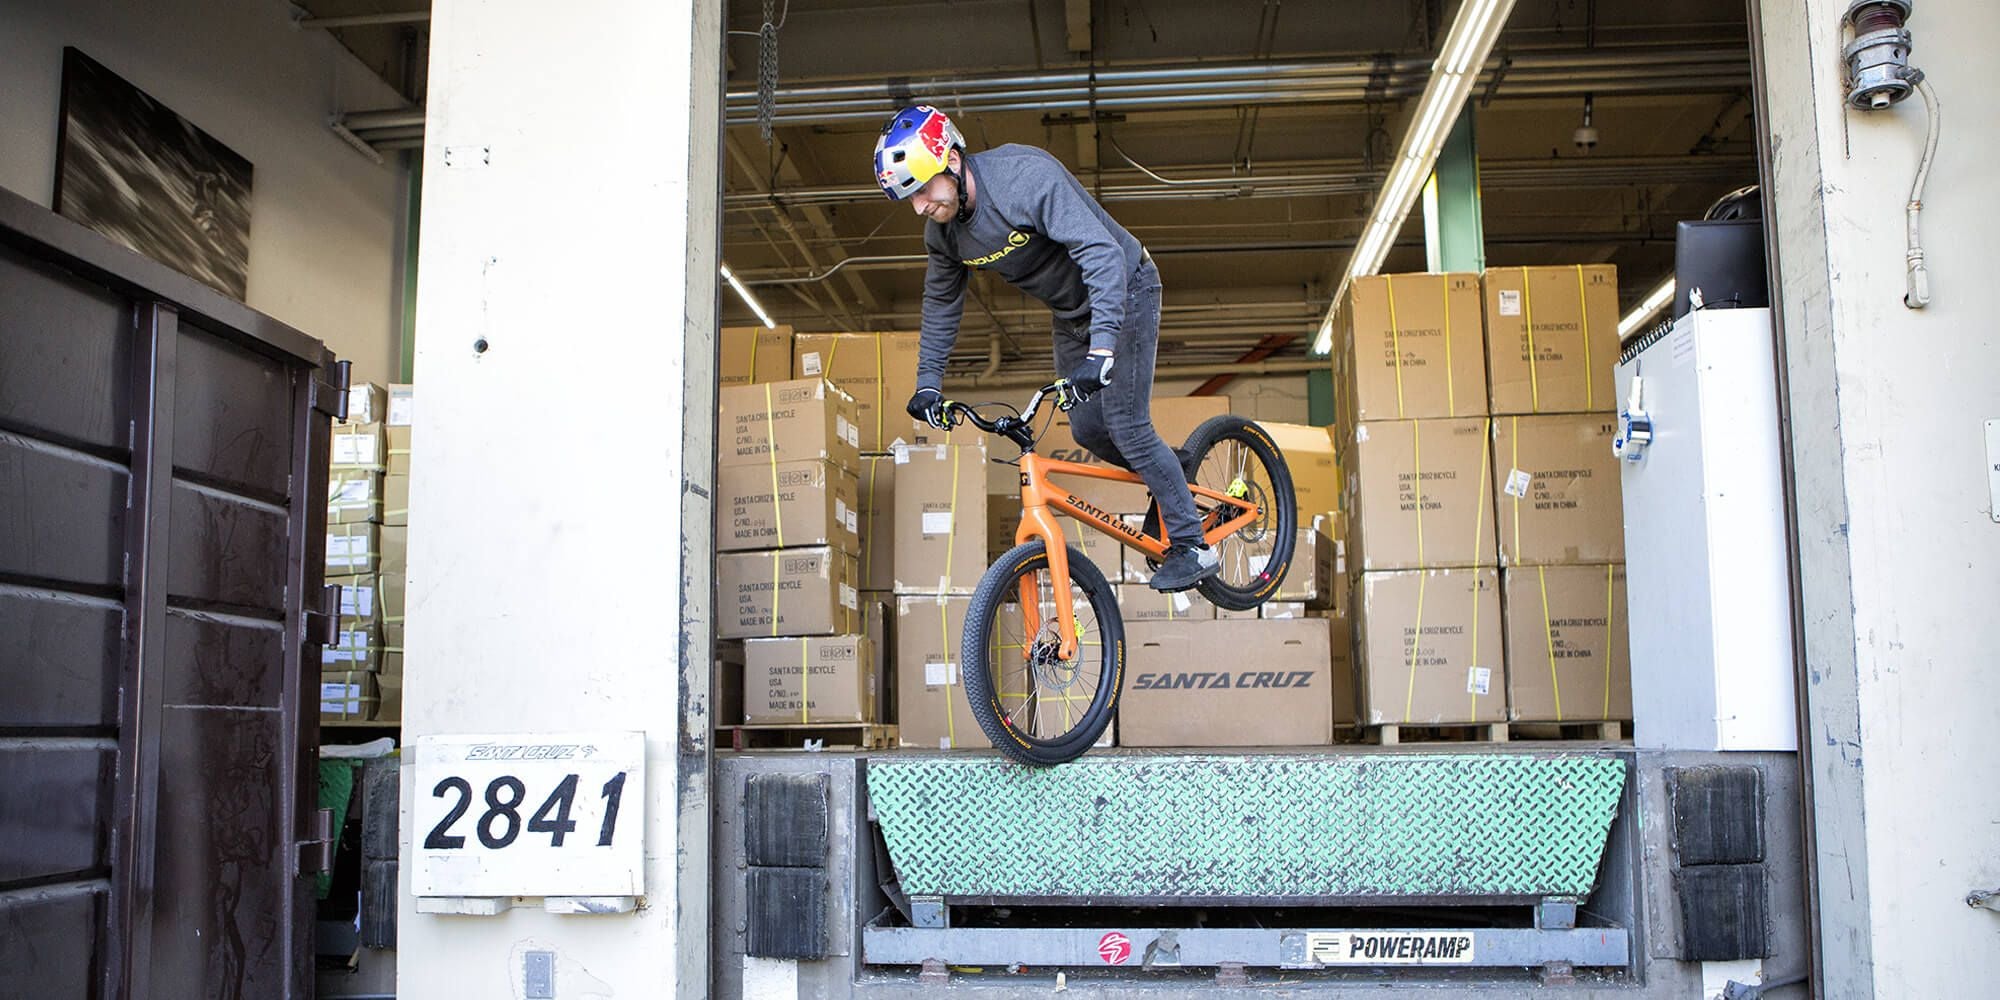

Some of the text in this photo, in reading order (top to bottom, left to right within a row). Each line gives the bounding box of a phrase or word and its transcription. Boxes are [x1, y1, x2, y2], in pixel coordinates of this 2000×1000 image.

[736, 426, 748, 434] USA
[736, 446, 754, 456] MADE
[1434, 471, 1456, 480] BICYCLE
[734, 496, 754, 506] SANTA
[754, 494, 769, 503] CRUZ
[734, 507, 746, 516] USA
[1066, 495, 1111, 524] SANTA
[735, 529, 752, 538] MADE
[738, 583, 759, 593] SANTA
[739, 594, 752, 603] USA
[740, 617, 757, 626] MADE
[1440, 625, 1464, 634] BICYCLE
[769, 666, 791, 676] SANTA
[809, 665, 836, 674] BICYCLE
[769, 678, 782, 686] USA
[1132, 671, 1315, 690] SANTA CRUZ
[769, 701, 786, 709] MADE
[424, 771, 627, 849] 2841
[1350, 936, 1470, 959] POWERAMP
